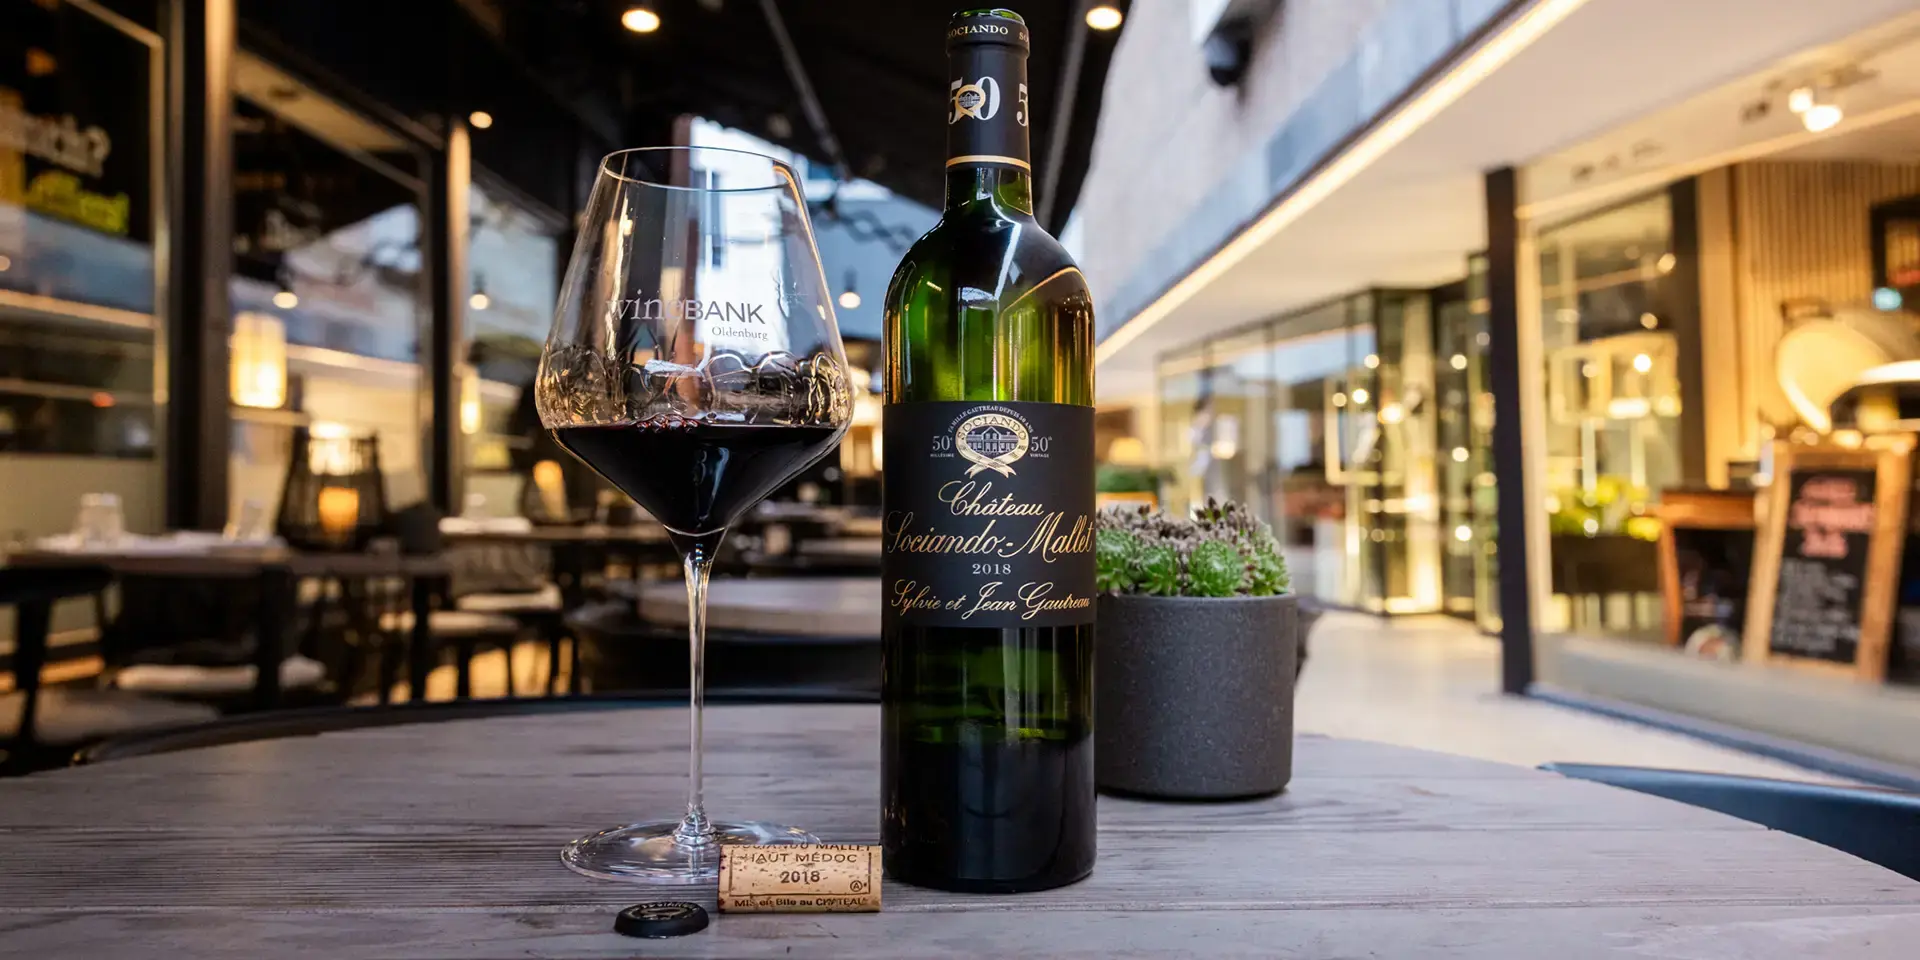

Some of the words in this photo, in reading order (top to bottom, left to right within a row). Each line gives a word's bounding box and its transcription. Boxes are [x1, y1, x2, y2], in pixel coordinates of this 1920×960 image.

[711, 326, 769, 341] Oldenburg
[957, 416, 1027, 440] SOCIANDO
[938, 480, 1044, 516] Château
[972, 563, 1012, 575] 2018
[891, 579, 941, 616] Sylvie
[945, 594, 967, 610] et
[961, 581, 1018, 620] Jean
[1018, 582, 1091, 620] Gautreau
[751, 854, 789, 863] HAUT
[795, 851, 858, 863] MÉDOC
[780, 870, 821, 885] 2018
